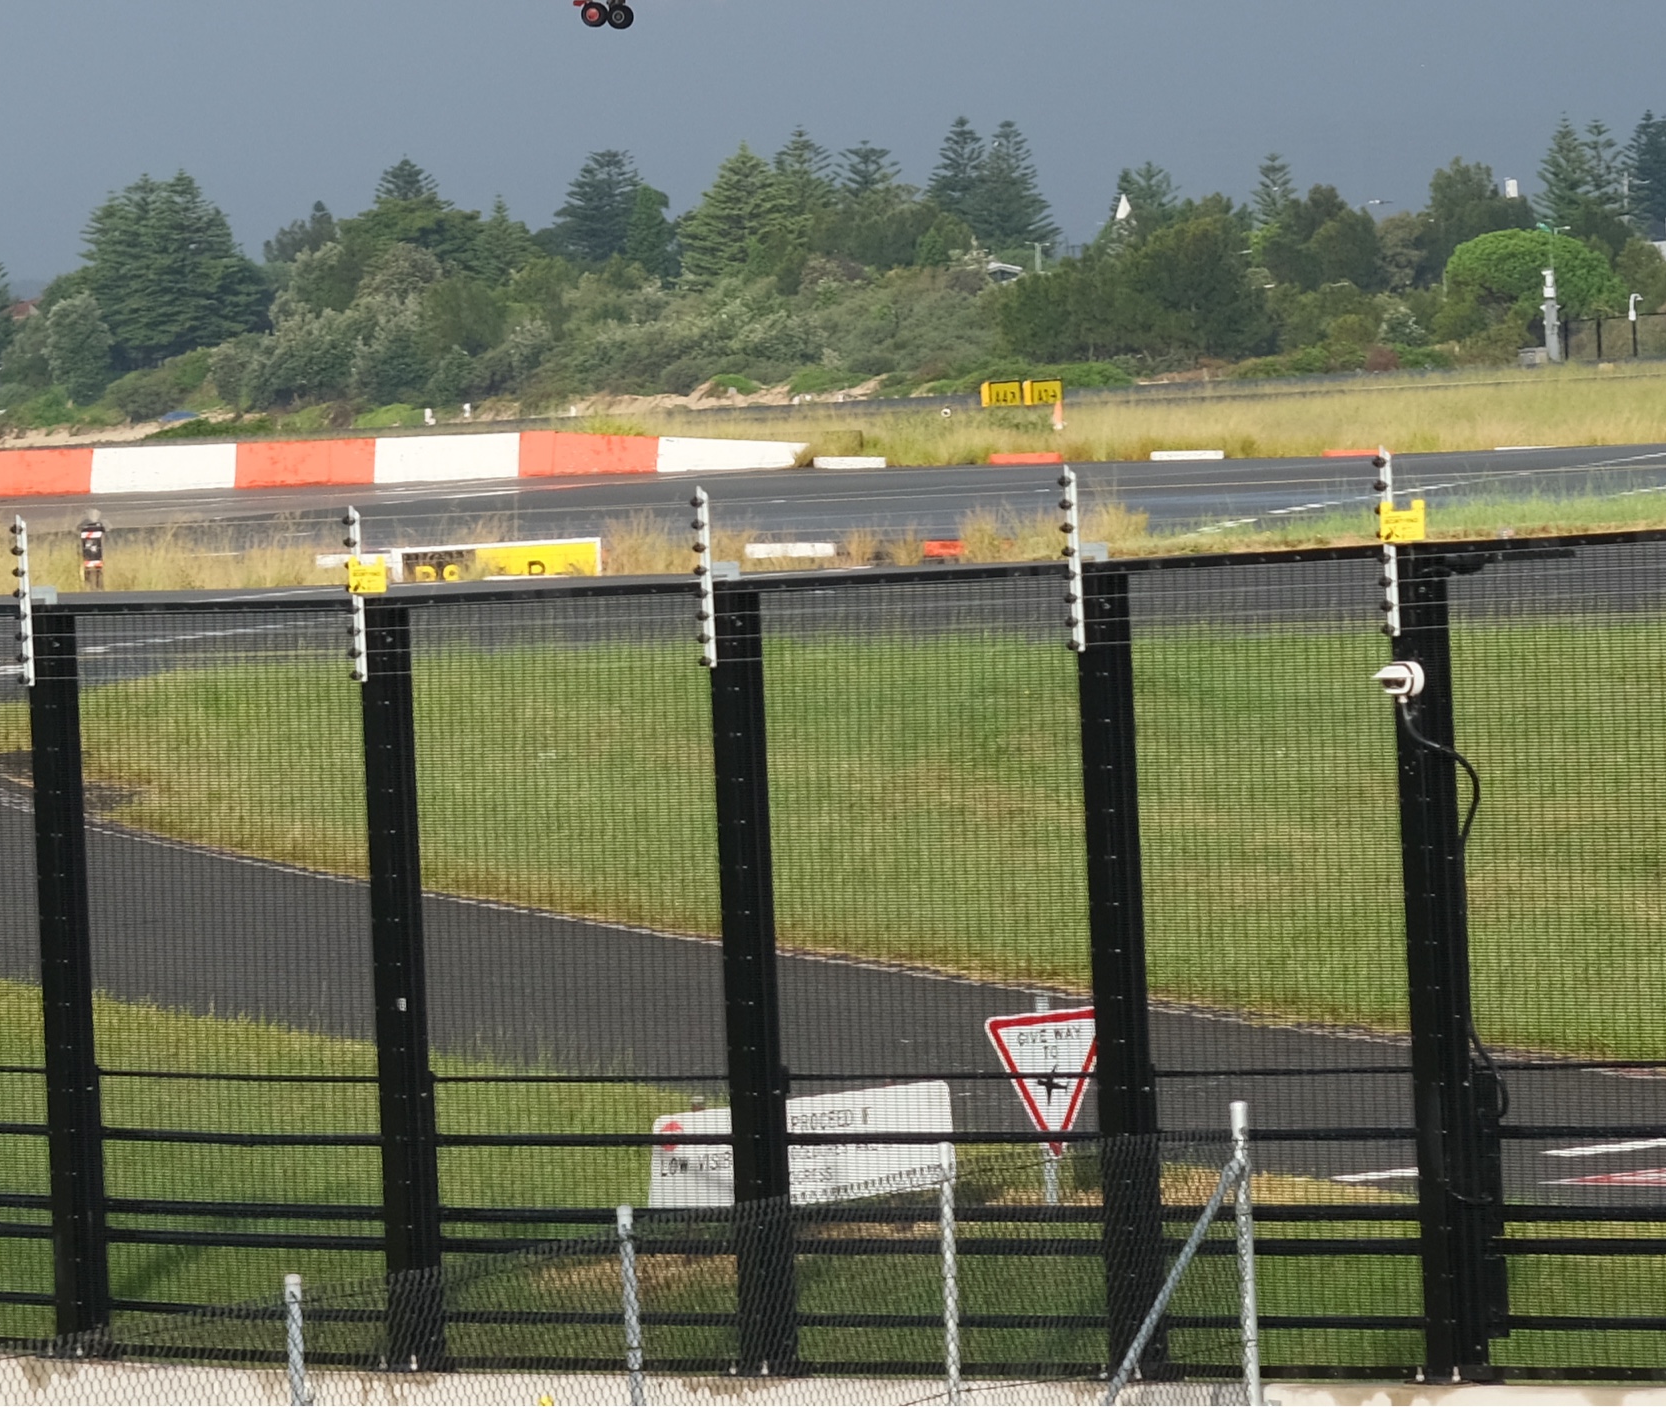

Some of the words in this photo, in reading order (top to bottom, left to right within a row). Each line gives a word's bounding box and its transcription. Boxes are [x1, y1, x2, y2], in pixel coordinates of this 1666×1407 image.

[1017, 1029, 1047, 1045] GIVE
[1054, 1026, 1080, 1040] WAY
[1043, 1045, 1059, 1059] TO
[790, 1109, 854, 1130] PROCEED
[661, 1155, 688, 1177] LOW
